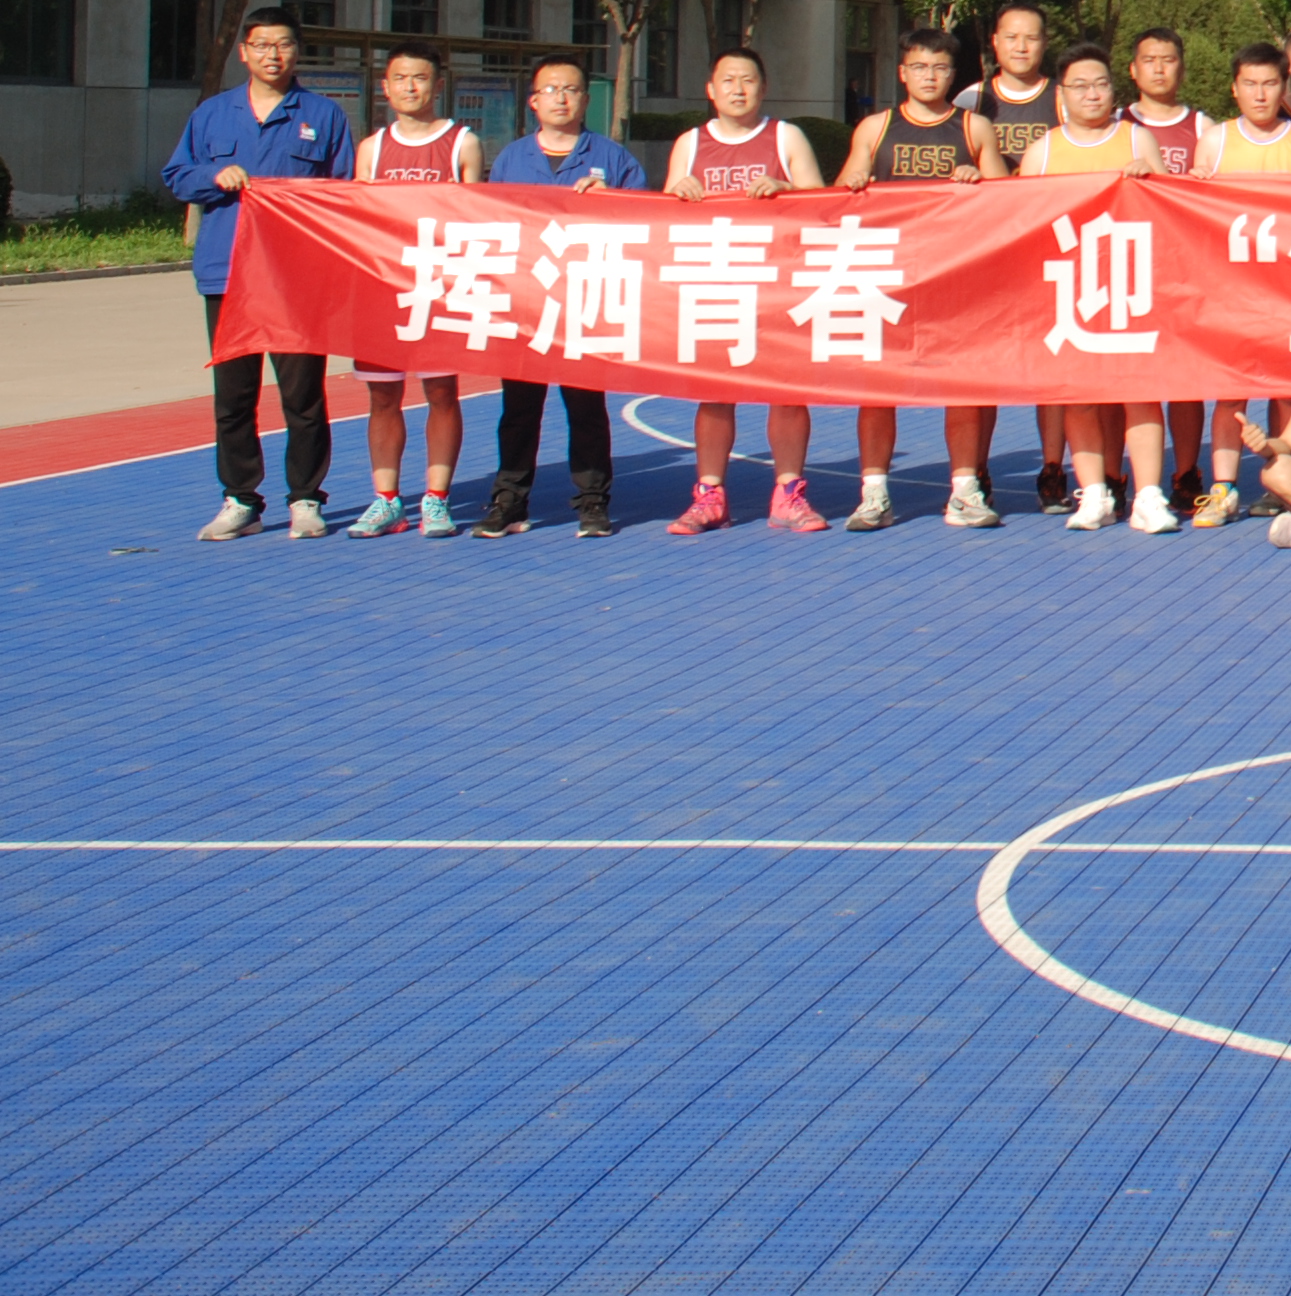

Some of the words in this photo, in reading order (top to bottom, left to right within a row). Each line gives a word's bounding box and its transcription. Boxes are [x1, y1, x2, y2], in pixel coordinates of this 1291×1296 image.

[992, 123, 1048, 154] HSS
[893, 144, 956, 177] HSS
[704, 164, 766, 191] HSS
[396, 215, 908, 367] 挥洒青春
